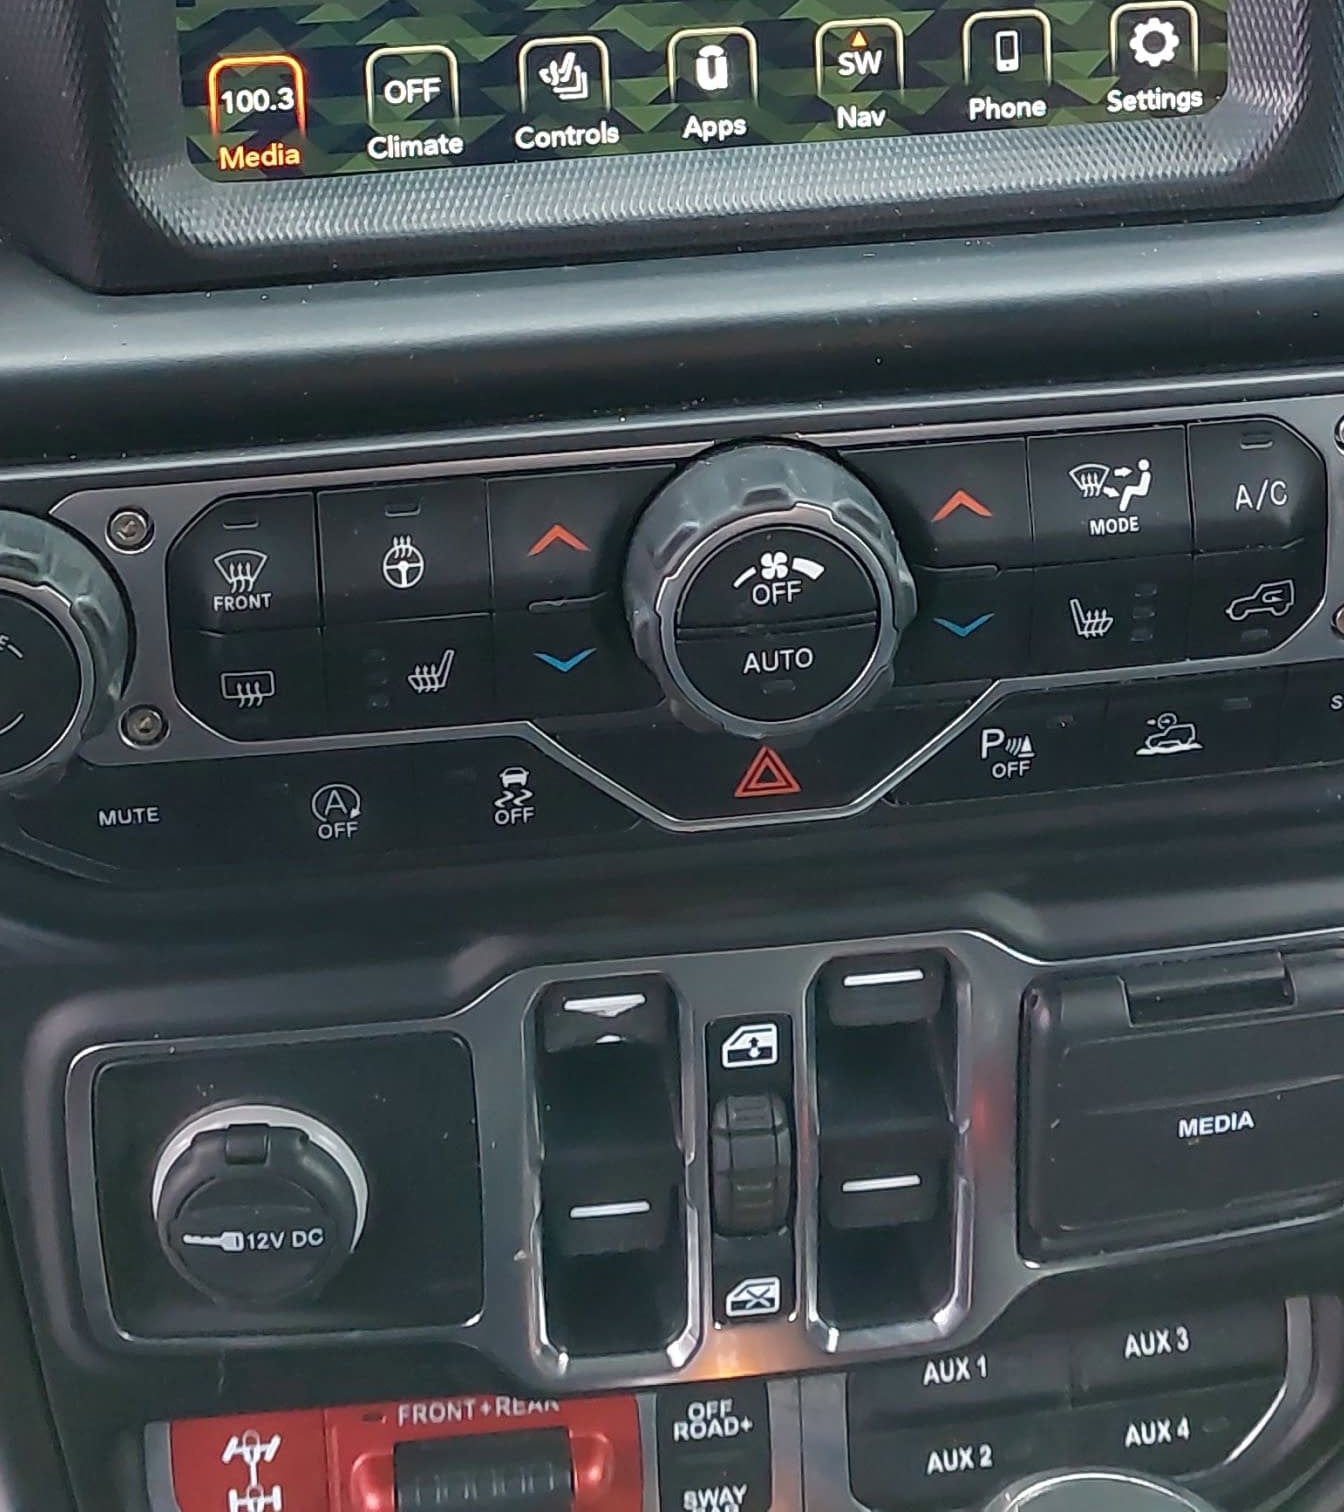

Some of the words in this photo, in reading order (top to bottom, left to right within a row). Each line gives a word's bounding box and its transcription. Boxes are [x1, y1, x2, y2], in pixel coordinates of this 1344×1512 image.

[837, 50, 882, 77] SW
[221, 88, 294, 114] 100.3
[383, 76, 441, 105] OFF
[1107, 89, 1203, 117] Settings
[836, 105, 886, 130] Nav
[969, 97, 1047, 122] Phone
[514, 121, 619, 151] Controls
[683, 115, 746, 143] Apps
[218, 143, 301, 171] Media
[367, 133, 464, 161] Climate
[1235, 480, 1288, 512] A/C
[1089, 515, 1140, 536] MODE
[213, 592, 272, 612] FRONT
[752, 581, 802, 605] OFF
[743, 647, 814, 674] AUTO
[992, 760, 1031, 779] OFF
[98, 806, 160, 827] MUTE
[318, 820, 358, 839] OFF
[494, 807, 534, 825] OFF
[1178, 1111, 1255, 1138] MEDIA
[246, 1230, 284, 1251] 12V
[291, 1228, 324, 1249] DC
[1124, 1332, 1171, 1359] AUX
[1175, 1327, 1190, 1352] 3
[923, 1360, 971, 1386] AUX
[977, 1356, 988, 1379] 1
[688, 1399, 732, 1420] OFF
[1124, 1421, 1172, 1448] AUX
[1175, 1417, 1190, 1441] 4
[926, 1448, 976, 1475] AUX
[978, 1444, 992, 1468] 2
